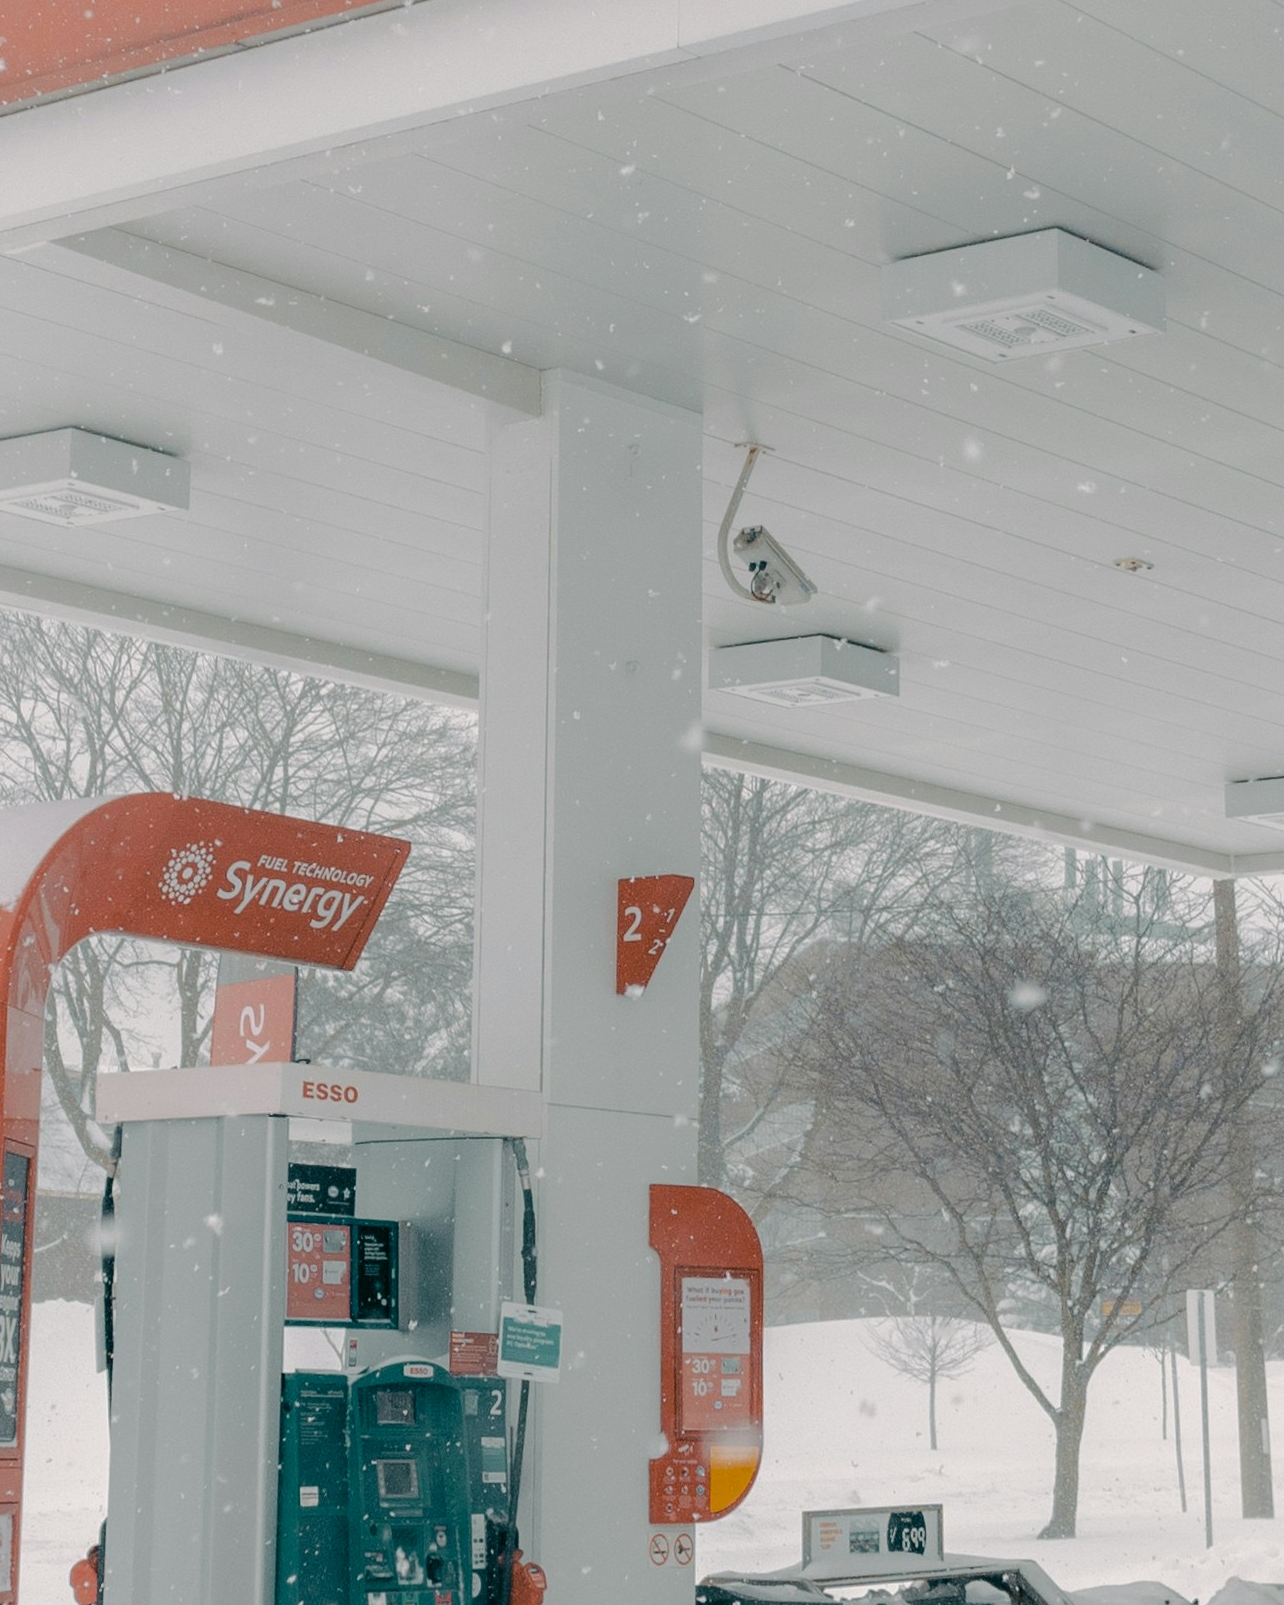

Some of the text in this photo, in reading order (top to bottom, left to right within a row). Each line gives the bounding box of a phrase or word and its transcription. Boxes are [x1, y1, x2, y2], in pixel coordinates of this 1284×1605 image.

[256, 854, 375, 888] FUEL TECHNOLOGY
[216, 860, 365, 932] Synergy
[623, 906, 642, 942] 2
[302, 1081, 359, 1104] ESSO
[292, 1232, 314, 1253] 30
[293, 1263, 310, 1284] 10
[692, 1359, 710, 1374] 30
[692, 1381, 707, 1396] 10
[489, 1389, 502, 1416] 2
